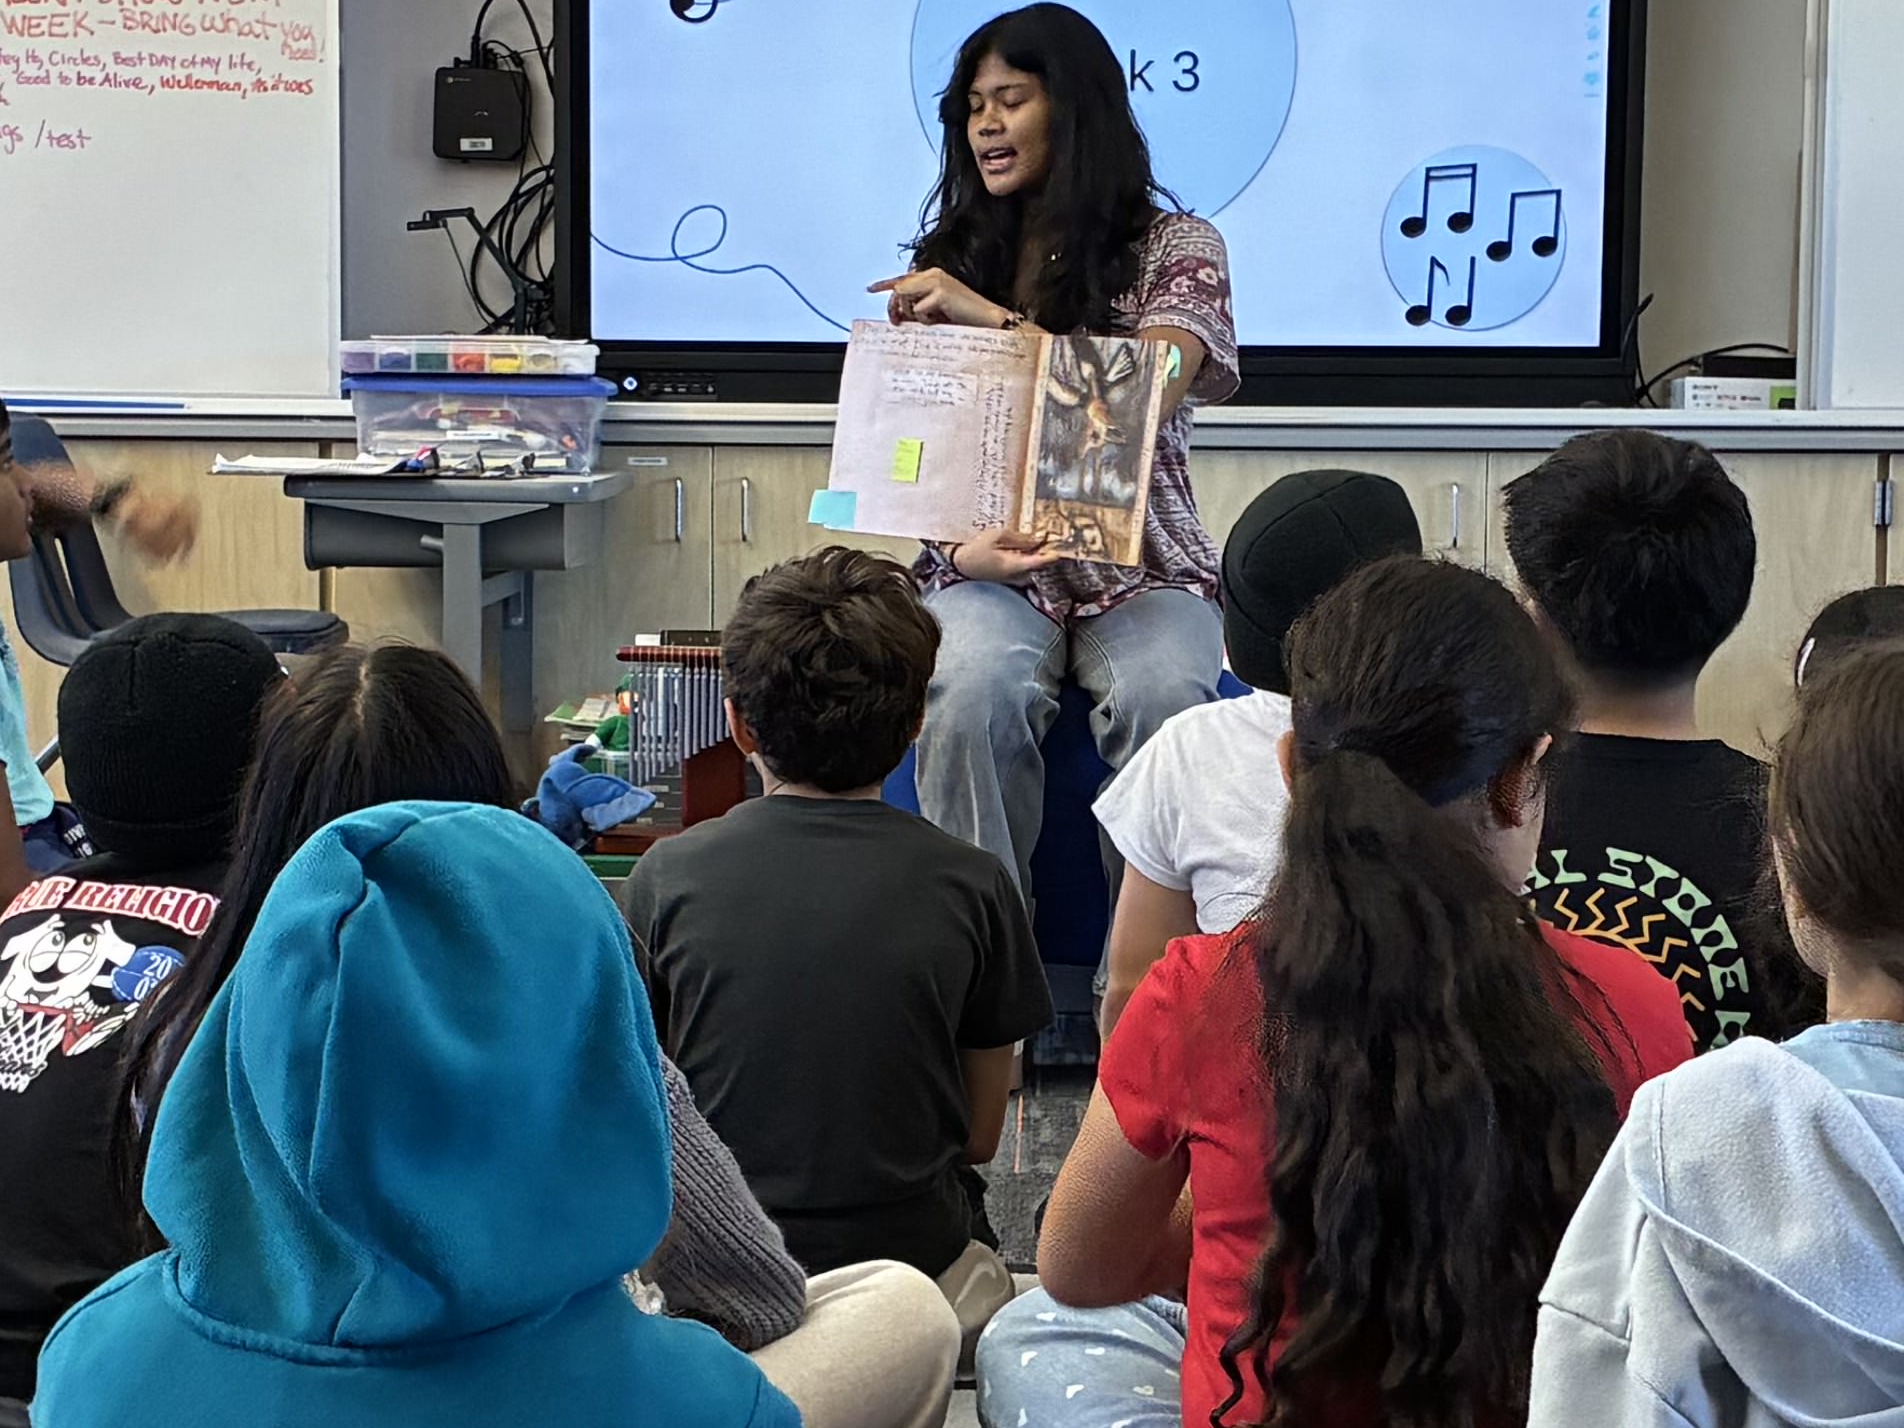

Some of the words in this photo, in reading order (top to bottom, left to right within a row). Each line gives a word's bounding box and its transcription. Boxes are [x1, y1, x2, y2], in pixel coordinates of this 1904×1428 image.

[0, 10, 95, 38] WEEK
[121, 8, 196, 36] BRING
[1172, 50, 1200, 92] 3
[63, 880, 220, 937] RELIGIO
[144, 955, 172, 980] 20
